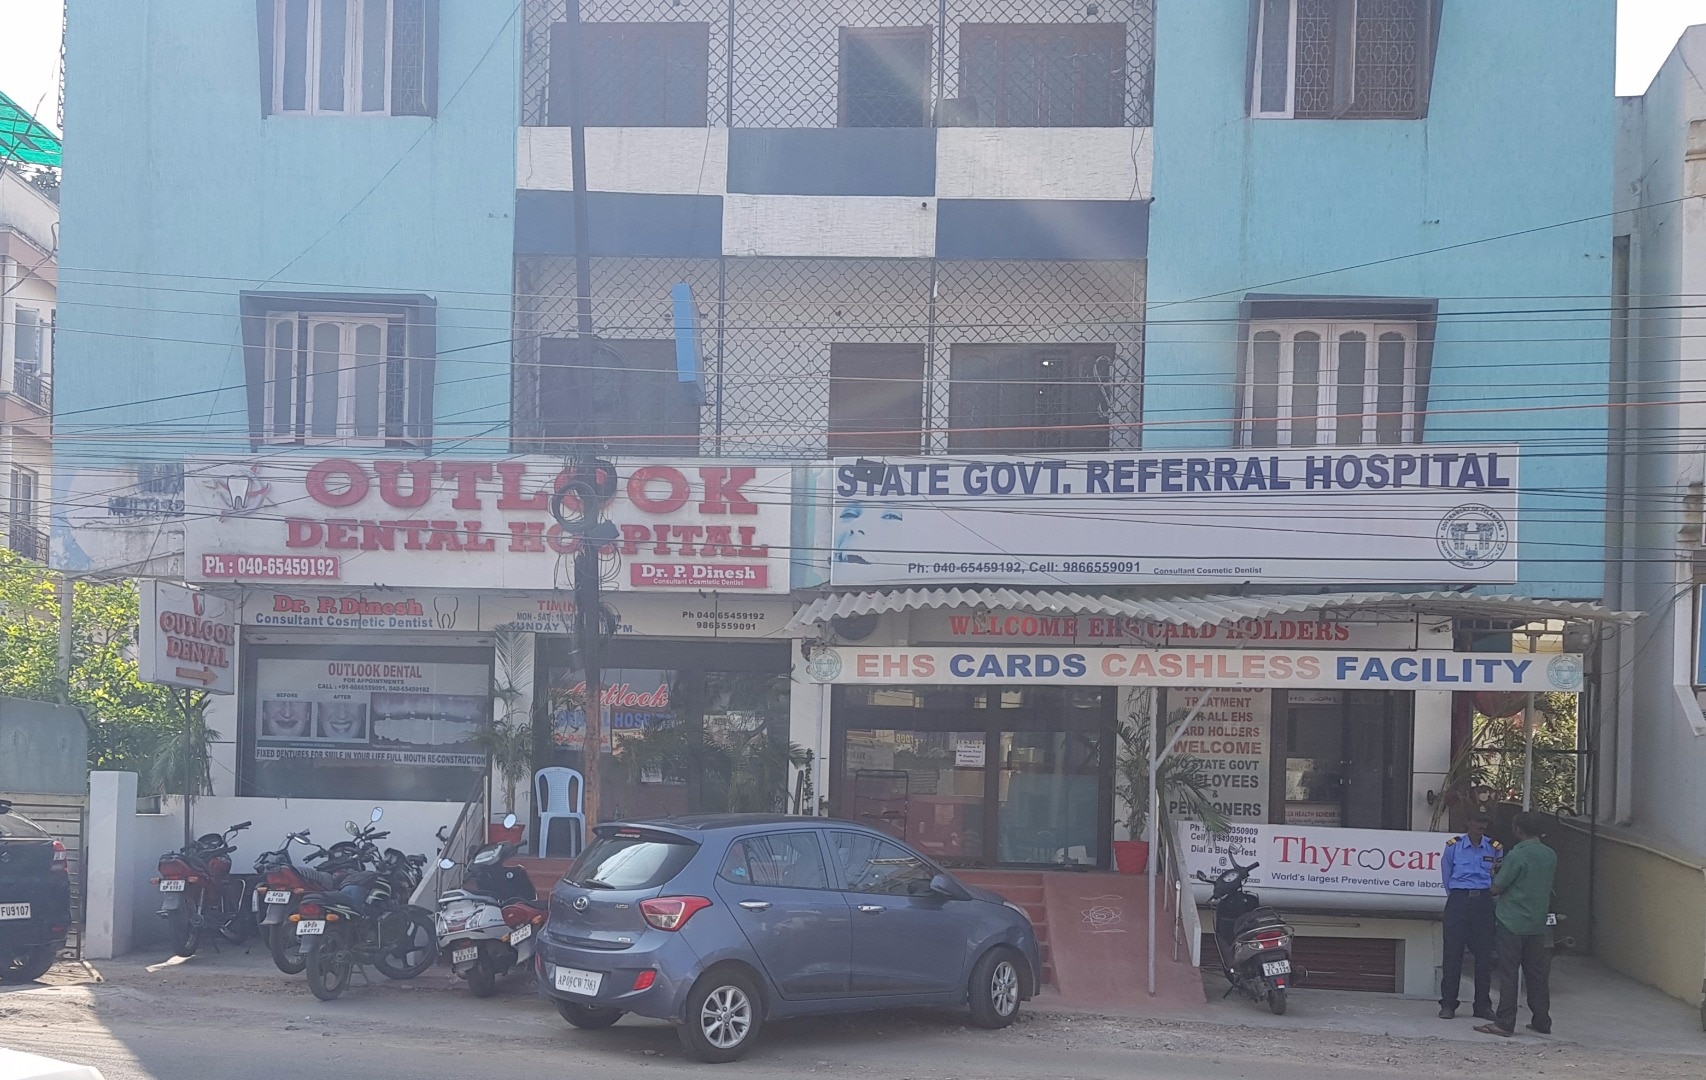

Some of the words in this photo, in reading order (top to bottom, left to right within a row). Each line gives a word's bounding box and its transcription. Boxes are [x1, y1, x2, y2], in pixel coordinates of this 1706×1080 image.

[962, 459, 1072, 496] GOVT.
[1086, 456, 1291, 495] REFERRAL
[1305, 452, 1510, 490] HOSPITAL
[286, 517, 496, 552] DENTAL
[508, 522, 768, 558] HOPITAL
[205, 556, 225, 573] Ph
[237, 558, 334, 577] 040-65459192
[641, 564, 668, 578] Dr.
[673, 565, 687, 578] P.
[692, 565, 756, 579] Dinesh
[907, 562, 929, 574] Ph:
[932, 562, 1025, 576] 040-65459192,
[1029, 561, 1058, 573] Cell:
[1062, 561, 1141, 573] 9866559091
[1153, 567, 1195, 575] Consultant
[1234, 566, 1262, 574] Dentist
[273, 594, 311, 613] Dr.
[537, 600, 578, 614] TIMIN
[255, 612, 324, 626] Consultant
[327, 616, 385, 628] Cosmetic
[389, 617, 434, 628] Dentist
[682, 611, 695, 619] Ph
[697, 611, 715, 619] 040
[160, 610, 235, 646] OUTLOOK
[508, 621, 560, 632] SUNDAY
[949, 615, 1078, 637] WELCOME
[166, 636, 229, 669] DENTAL
[328, 662, 381, 678] OUTLOOK
[383, 664, 422, 679] DENTAL
[857, 654, 936, 677] EHS
[949, 653, 1087, 678] CARDS
[1101, 653, 1321, 680] CASHLESS
[1336, 656, 1531, 684] FACILITY
[567, 681, 669, 708] tlook
[1185, 696, 1252, 708] TRATMENT
[1207, 712, 1228, 722] ALL
[1231, 712, 1254, 723] EHS
[1208, 726, 1260, 738] HOLDERS
[256, 749, 275, 758] FIXED
[1172, 740, 1263, 755] WELCOME
[1228, 760, 1260, 771] GOVT
[1169, 800, 1261, 817] PENONERS
[1190, 823, 1200, 831] Ph
[1190, 832, 1206, 841] Cell
[1191, 844, 1206, 853] Dial
[1273, 836, 1441, 872] Thyrocar
[1219, 856, 1228, 866] @
[1271, 872, 1305, 882] World's
[1307, 873, 1339, 885] largest
[1341, 875, 1390, 887] Preventive
[1392, 877, 1414, 888] Care
[1417, 879, 1445, 889] labora
[1, 905, 29, 917] FU9107
